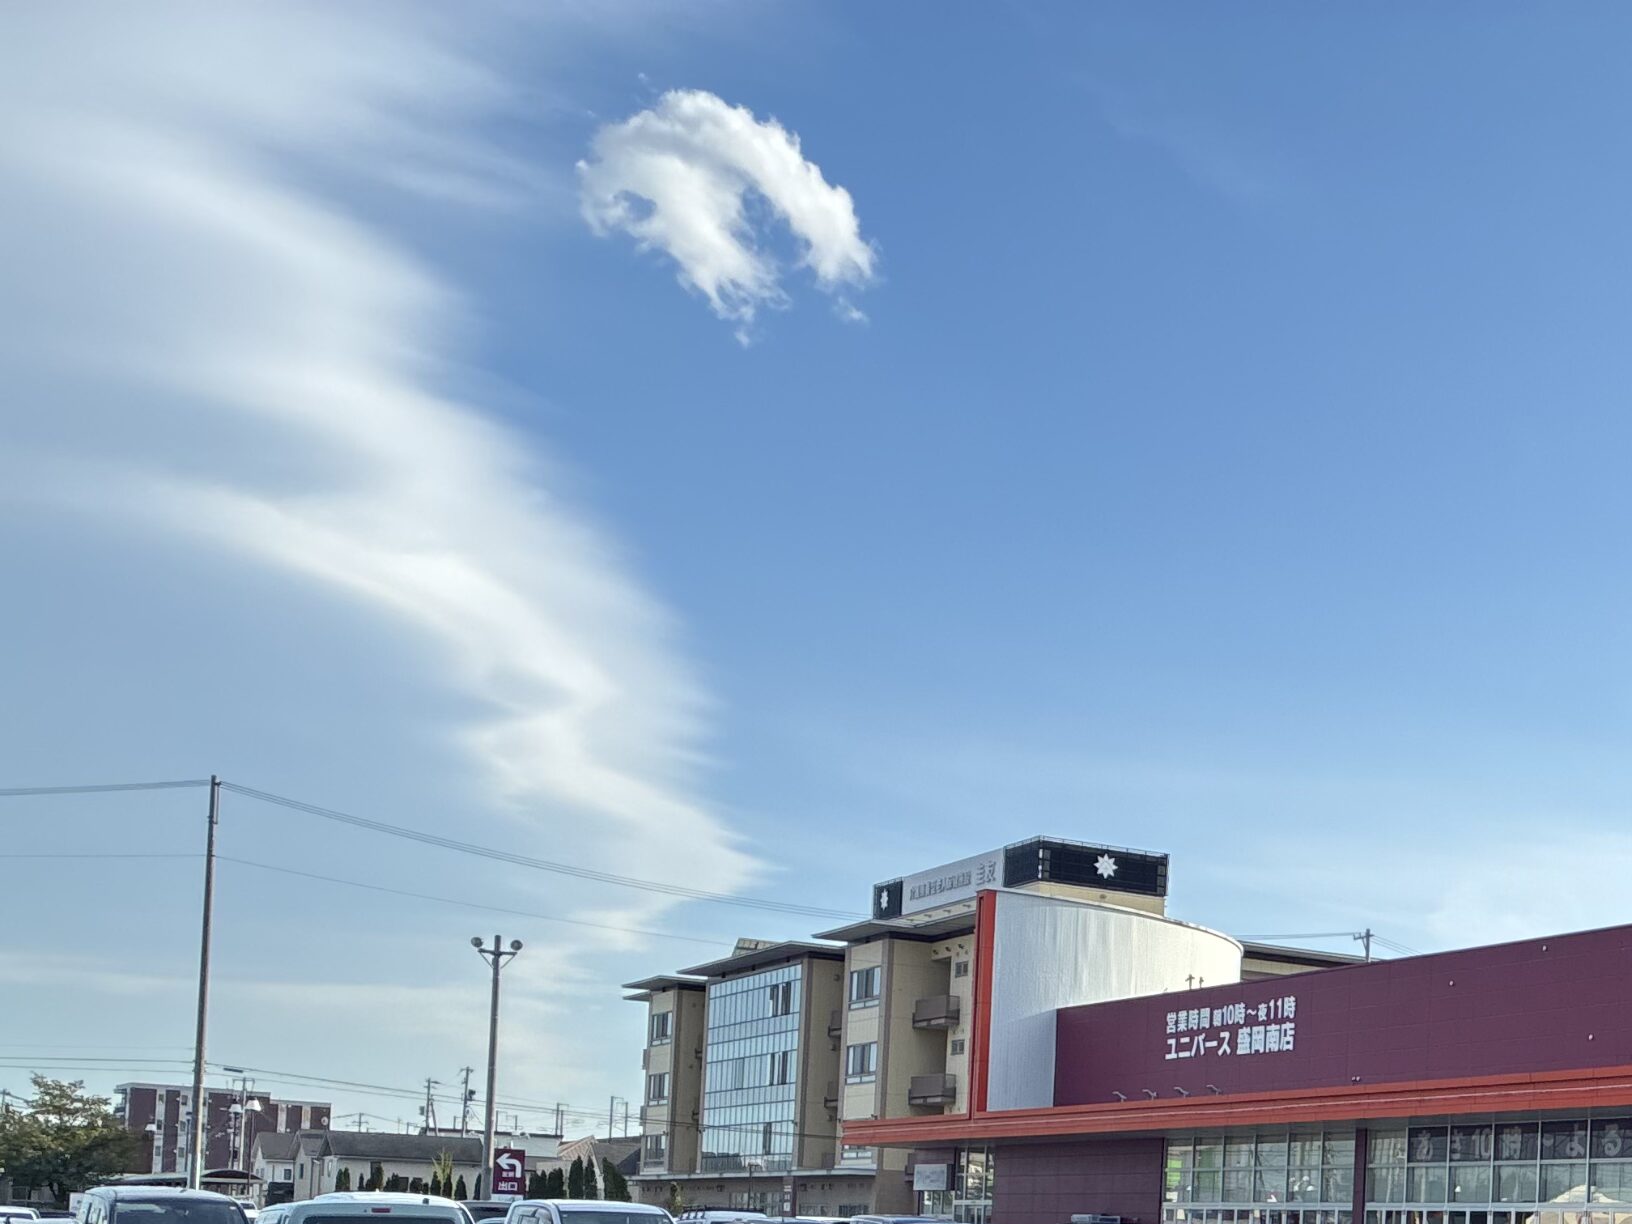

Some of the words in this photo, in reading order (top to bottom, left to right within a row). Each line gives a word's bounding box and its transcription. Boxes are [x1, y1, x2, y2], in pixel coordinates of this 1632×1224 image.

[1166, 1007, 1211, 1034] 営業時間
[1165, 1031, 1231, 1060] ユニバース
[1236, 1022, 1295, 1055] 盛岡南店
[498, 1181, 518, 1191] 出口
